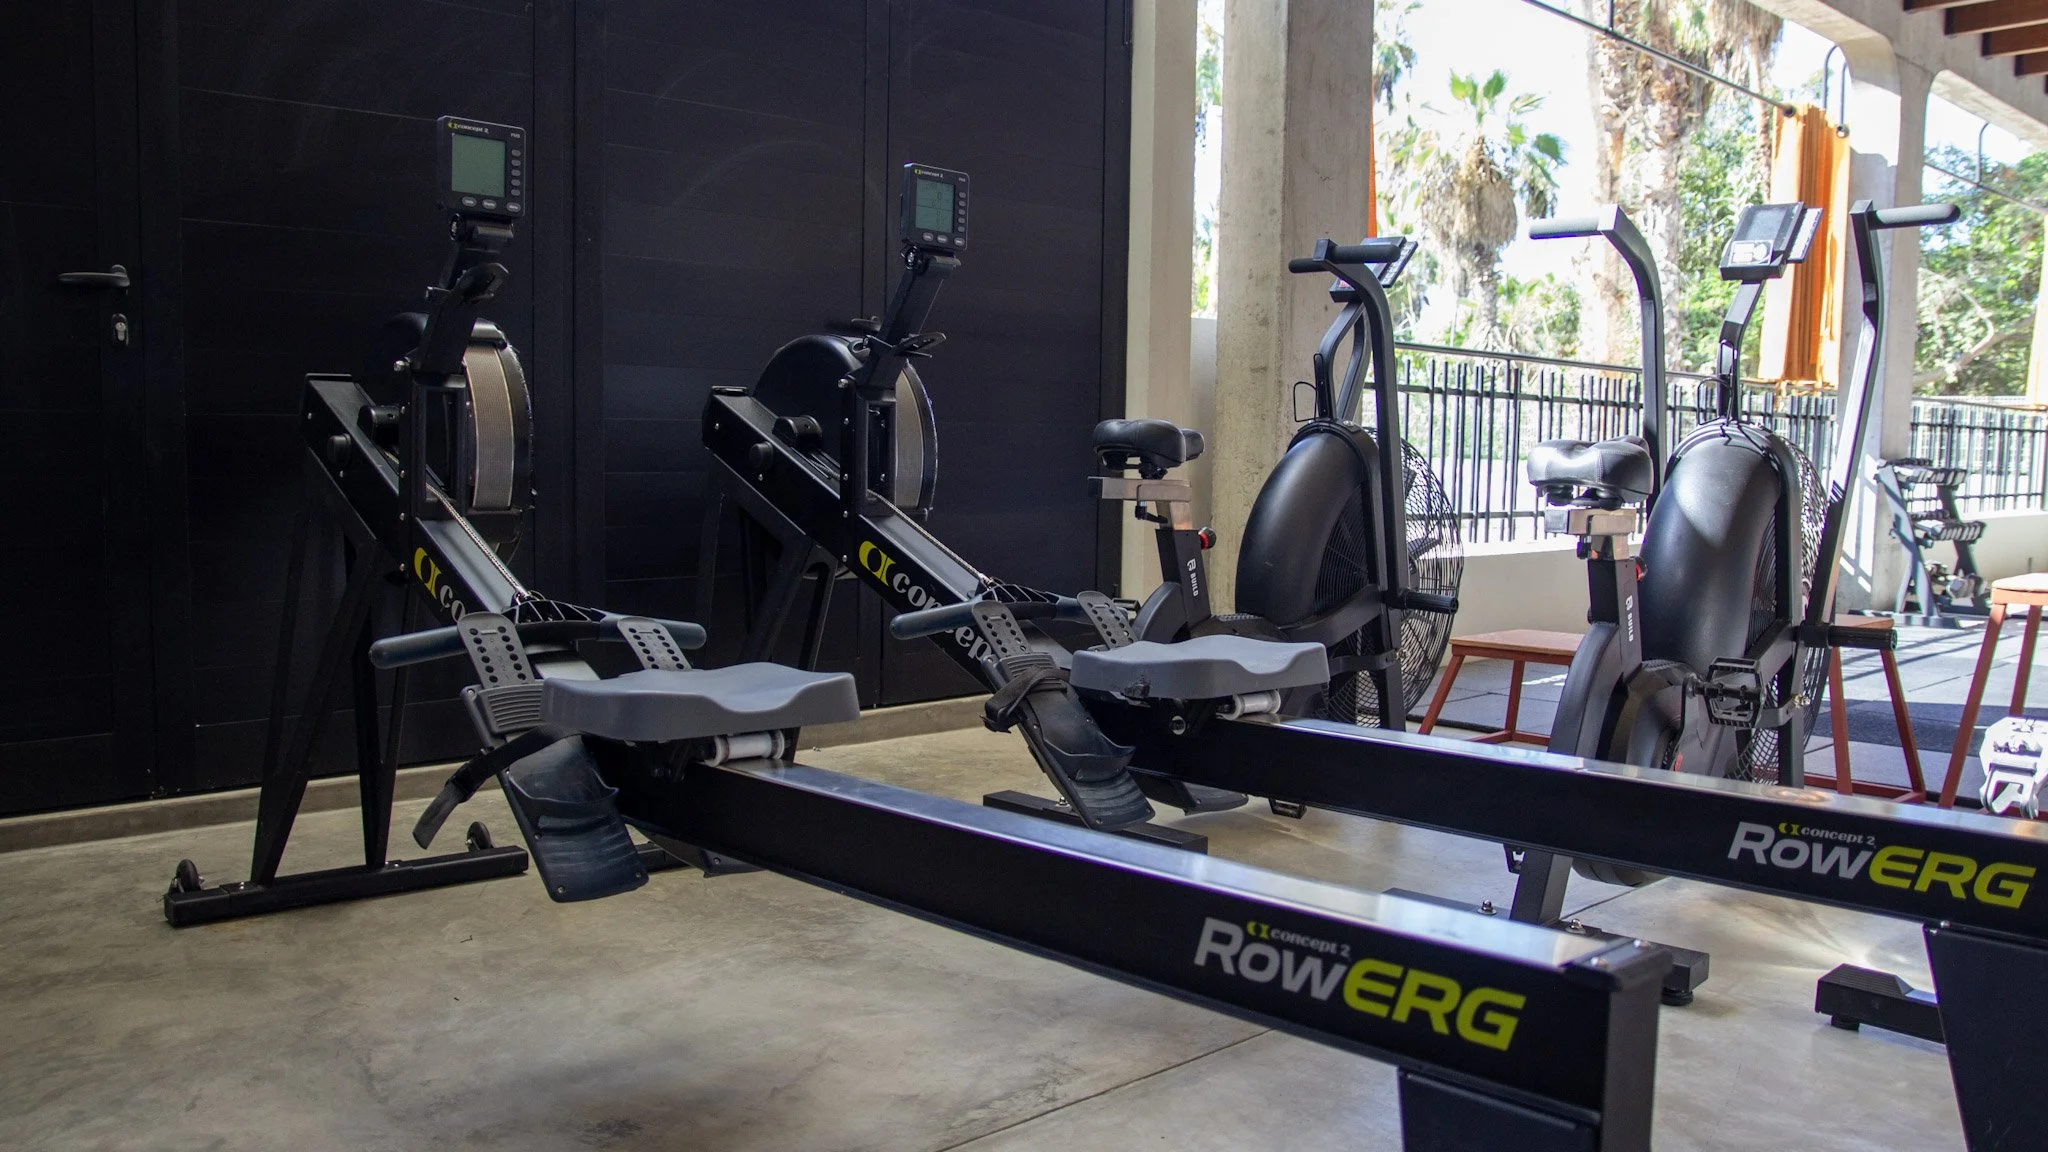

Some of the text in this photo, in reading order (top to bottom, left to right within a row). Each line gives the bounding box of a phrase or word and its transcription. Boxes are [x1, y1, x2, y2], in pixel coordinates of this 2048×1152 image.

[1190, 572, 1199, 597] BUILD
[1801, 826, 1876, 846] concept 2
[1270, 928, 1351, 958] concept 2
